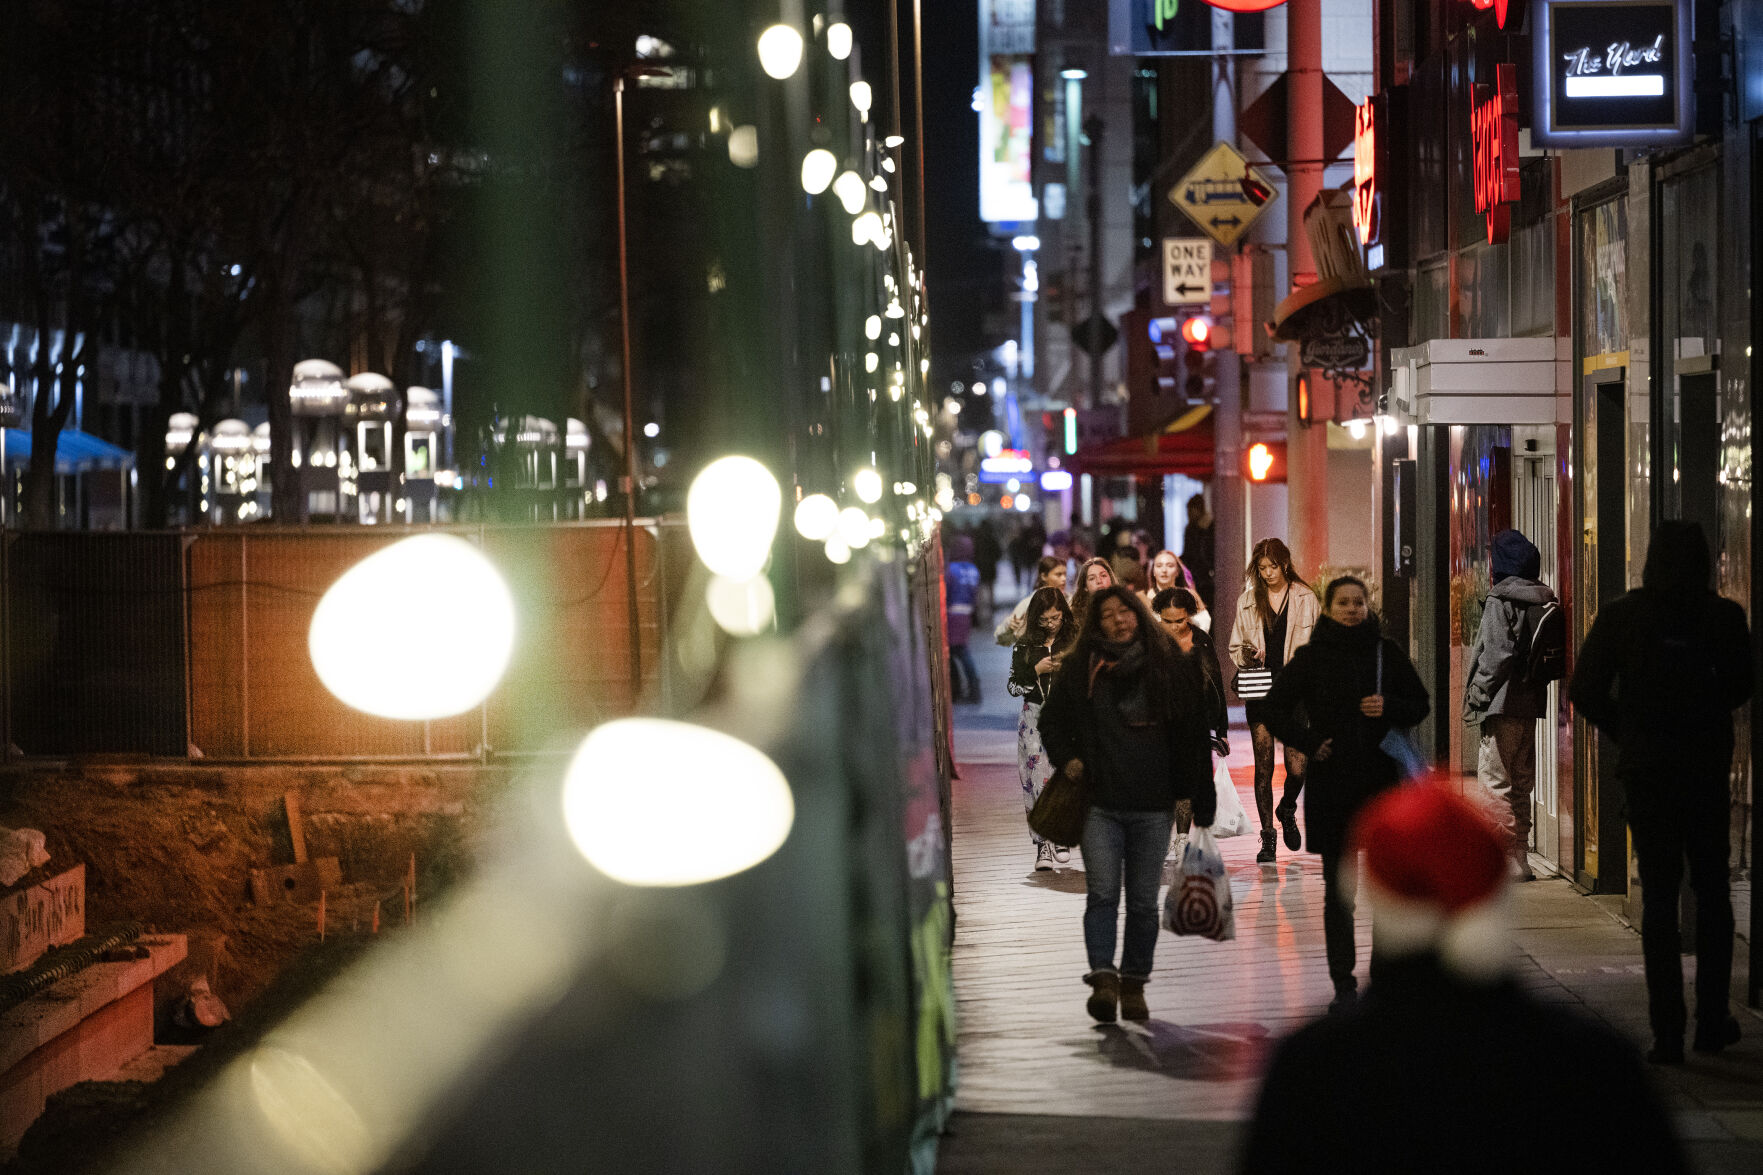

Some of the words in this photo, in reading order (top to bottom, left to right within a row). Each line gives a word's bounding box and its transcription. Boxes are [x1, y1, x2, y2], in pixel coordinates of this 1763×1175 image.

[1564, 47, 1601, 76] The
[1606, 34, 1663, 75] Yard
[1471, 64, 1506, 245] target
[1171, 245, 1206, 260] ONE
[1171, 263, 1207, 278] WAY
